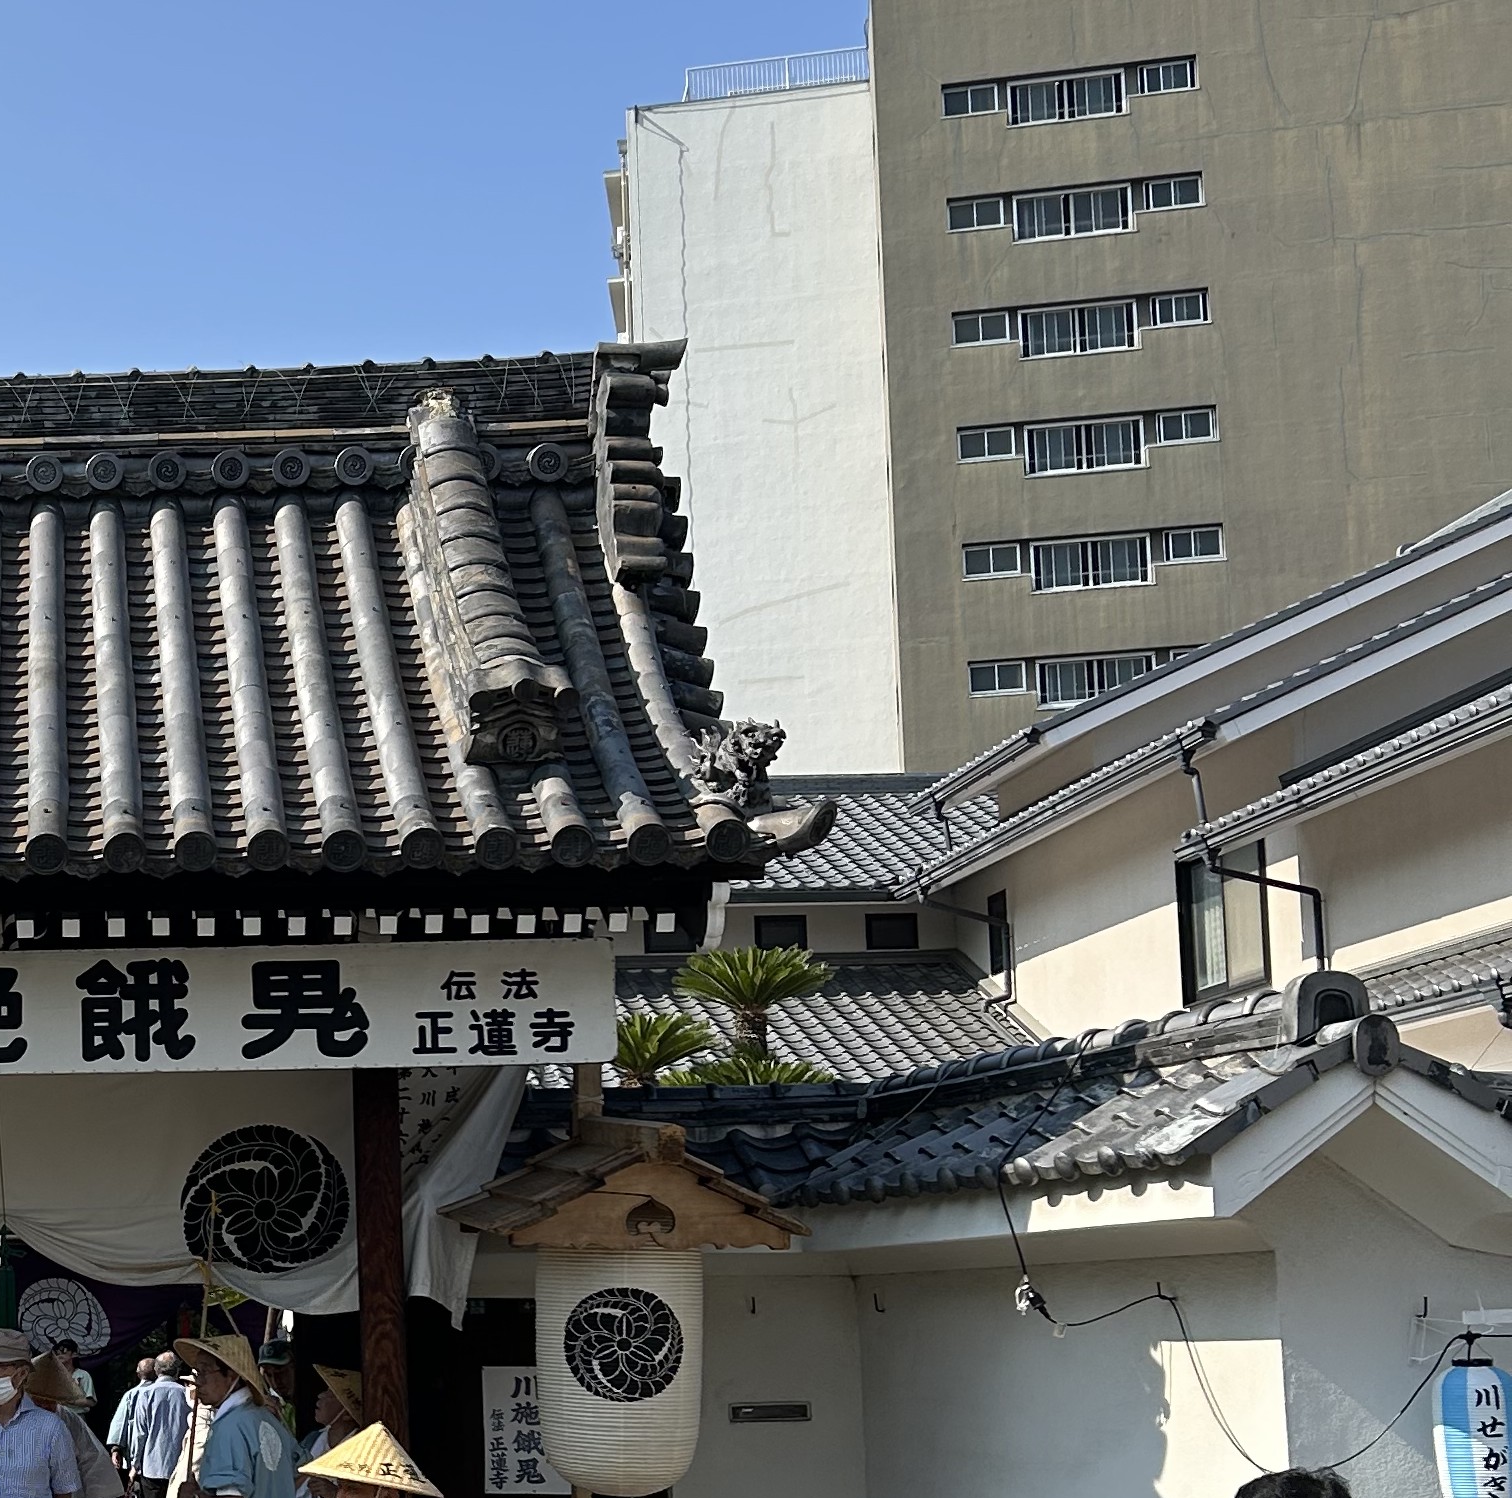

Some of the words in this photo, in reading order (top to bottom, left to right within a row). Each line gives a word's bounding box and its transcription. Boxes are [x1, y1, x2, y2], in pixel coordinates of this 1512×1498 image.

[440, 967, 540, 1001] 伝法
[412, 1007, 575, 1057] 正蓮寺
